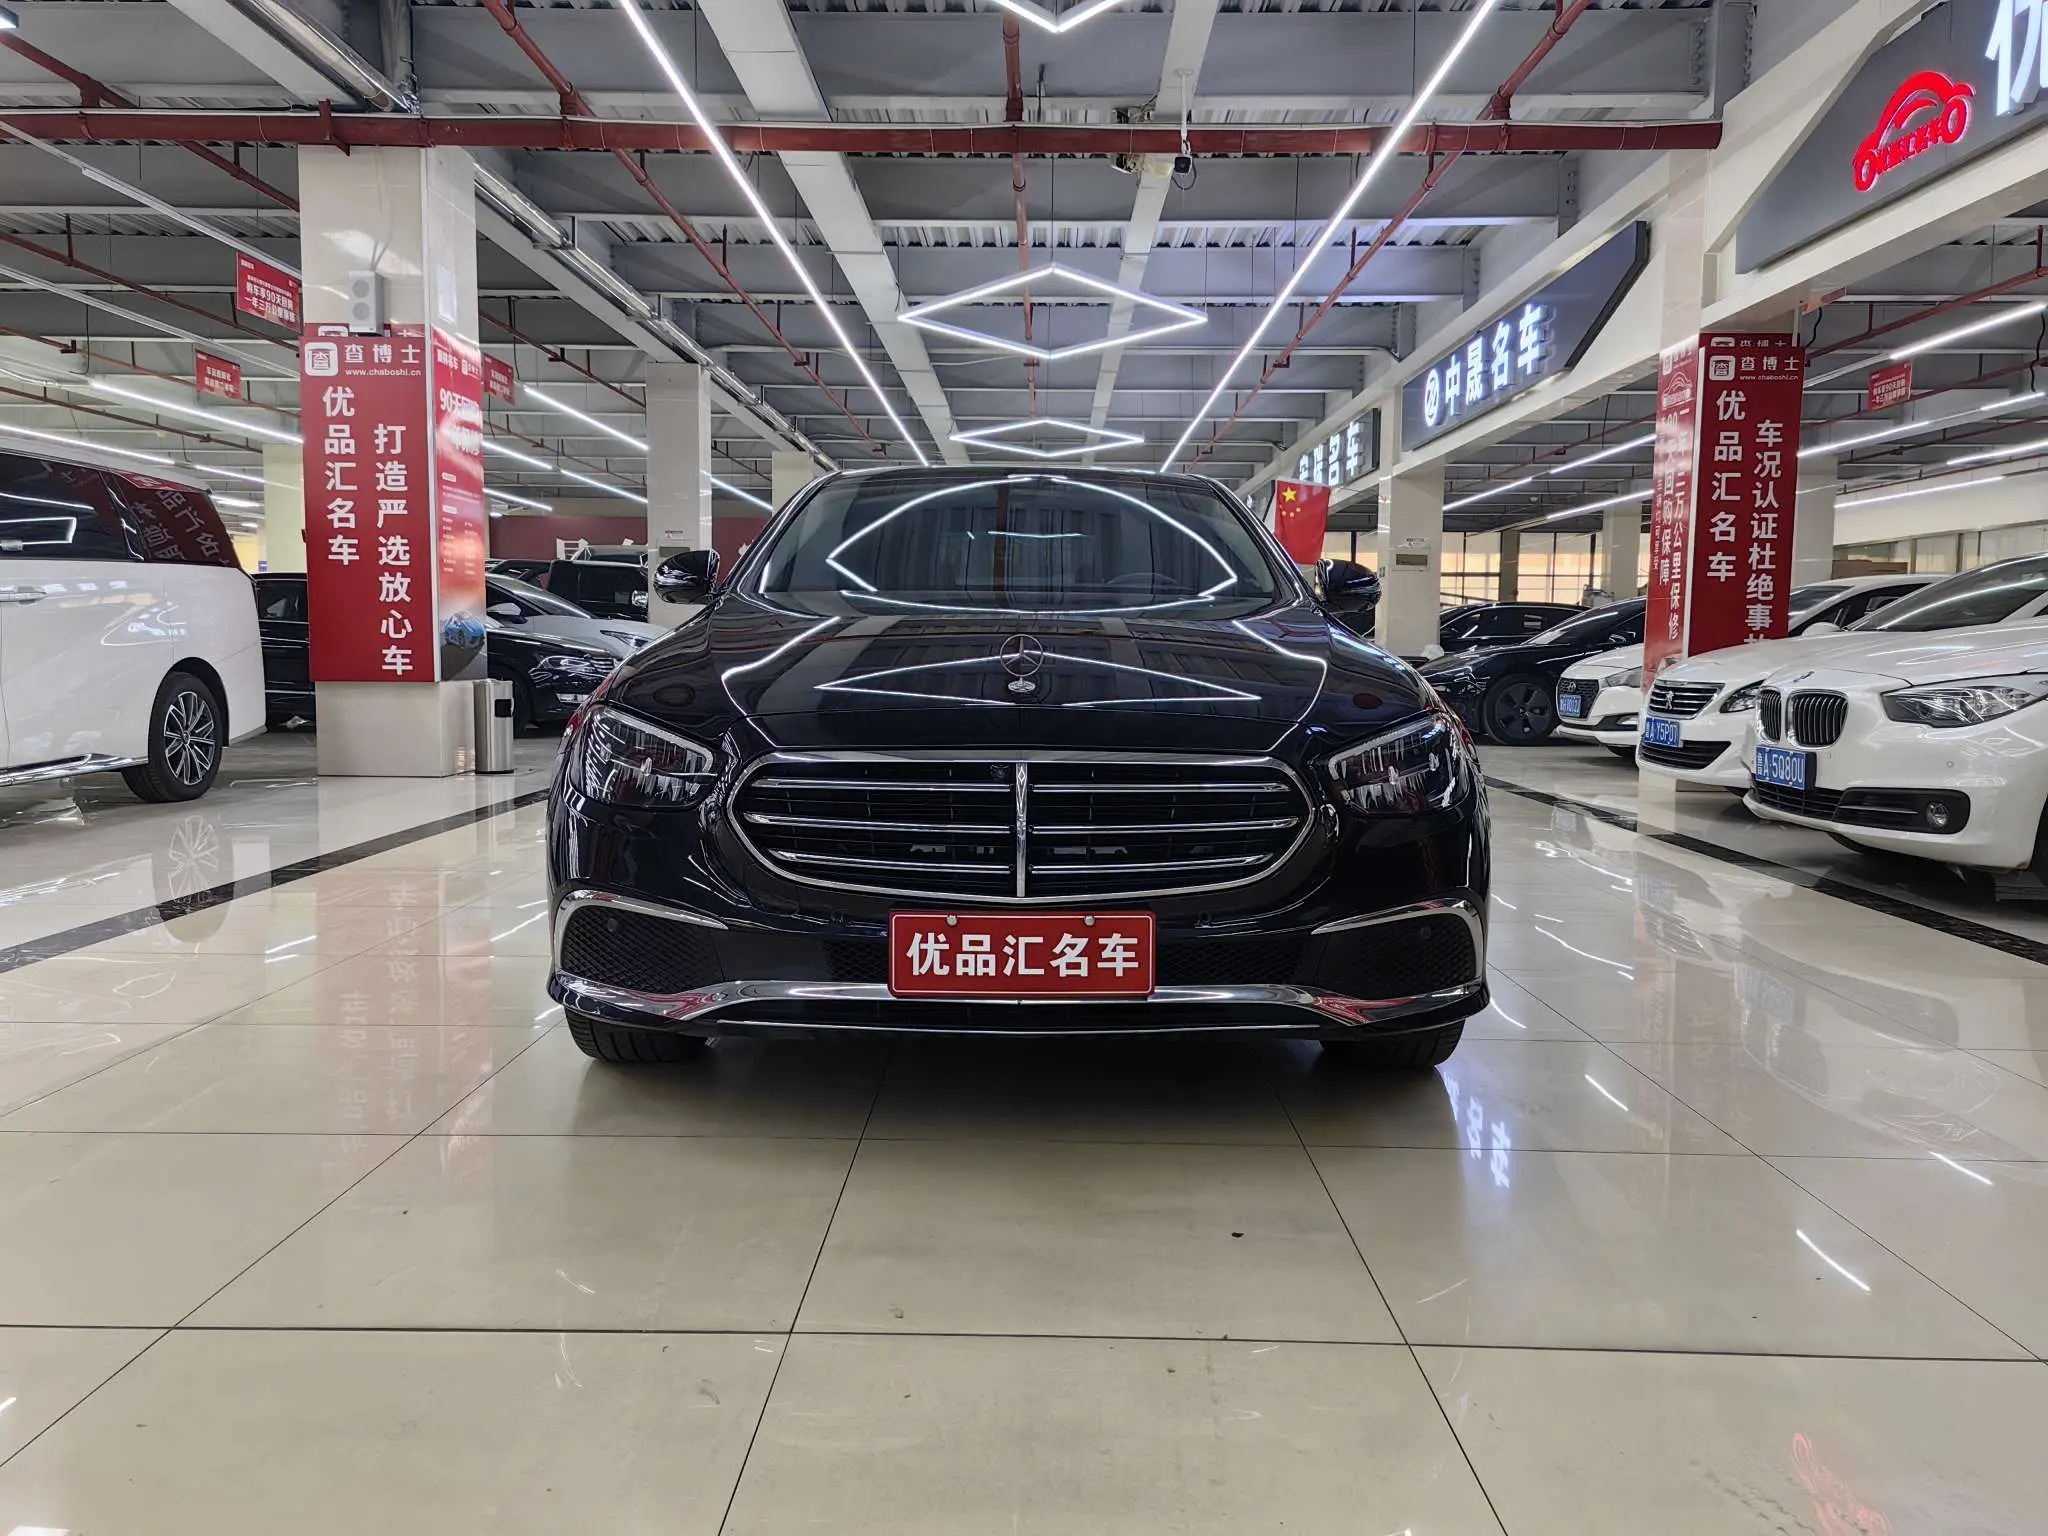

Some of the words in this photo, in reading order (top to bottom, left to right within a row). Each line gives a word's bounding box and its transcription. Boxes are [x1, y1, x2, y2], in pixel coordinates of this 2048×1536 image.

[344, 344, 421, 363] 查博士
[345, 368, 422, 376] www.chaboshi.cn
[1445, 303, 1547, 416] 中晟名车
[1740, 356, 1800, 371] 查博士
[322, 386, 360, 566] 优品汇名车
[1707, 390, 1746, 582] 优品汇名车
[1744, 419, 1783, 643] 车况认证杜绝事
[374, 423, 414, 676] 打造严选放心车
[906, 932, 1139, 977] 优品汇名车
